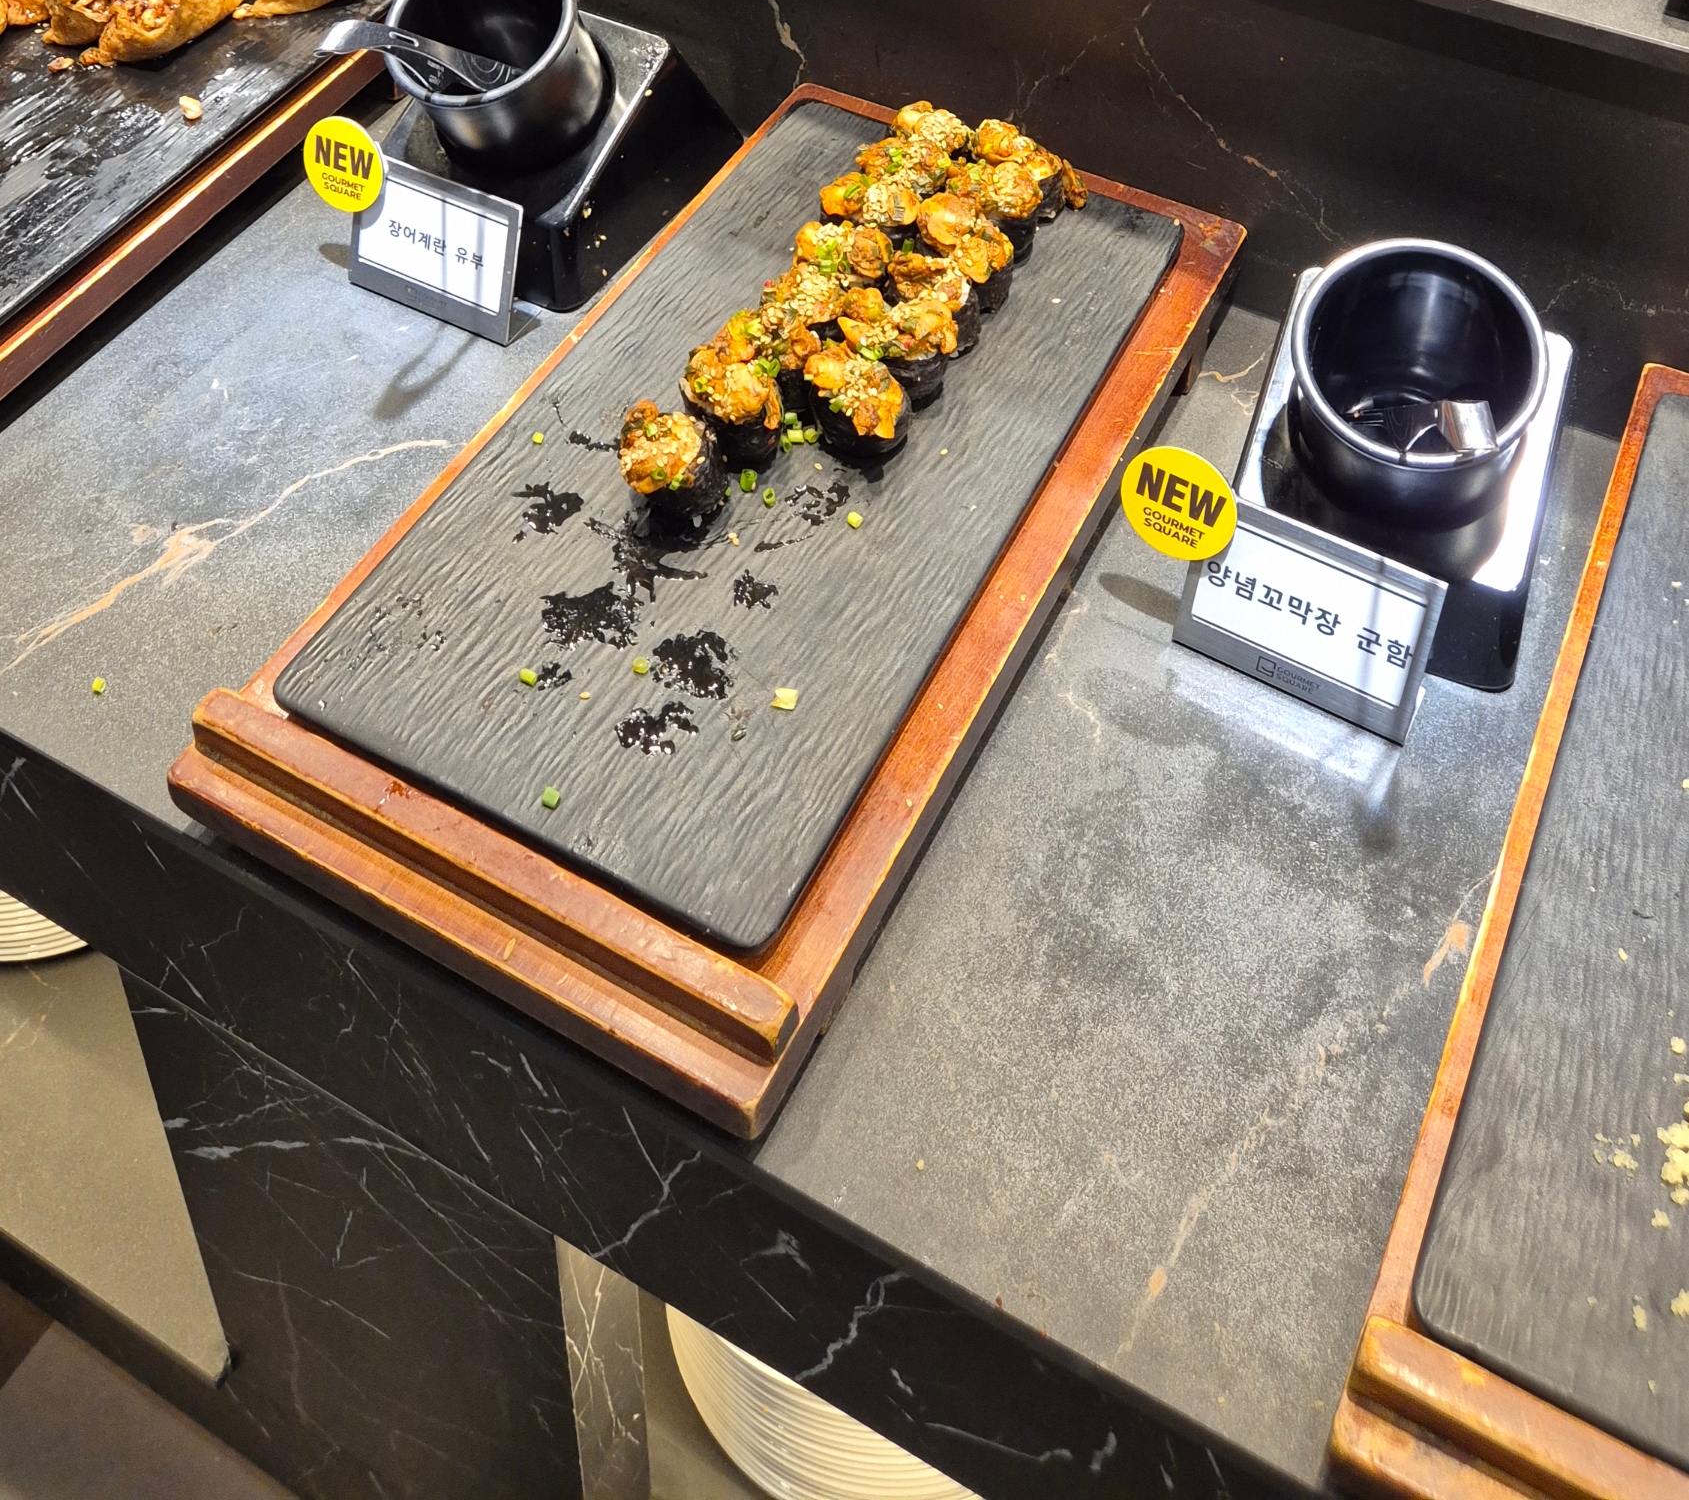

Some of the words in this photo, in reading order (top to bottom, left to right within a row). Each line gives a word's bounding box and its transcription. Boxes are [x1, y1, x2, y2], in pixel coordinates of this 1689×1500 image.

[314, 134, 374, 181] NEW
[321, 172, 365, 193] GOURMET
[323, 181, 362, 201] SQUARE
[388, 219, 447, 257] 장어계란
[454, 247, 485, 271] 유부
[1135, 461, 1228, 528] NEW
[1142, 506, 1206, 541] GOURMET
[1143, 517, 1199, 550] SQUARE
[1207, 560, 1342, 636] 양념꼬막장
[1356, 626, 1414, 669] 군함
[1275, 672, 1314, 695] SQUARE
[1276, 666, 1321, 691] GOURMET
